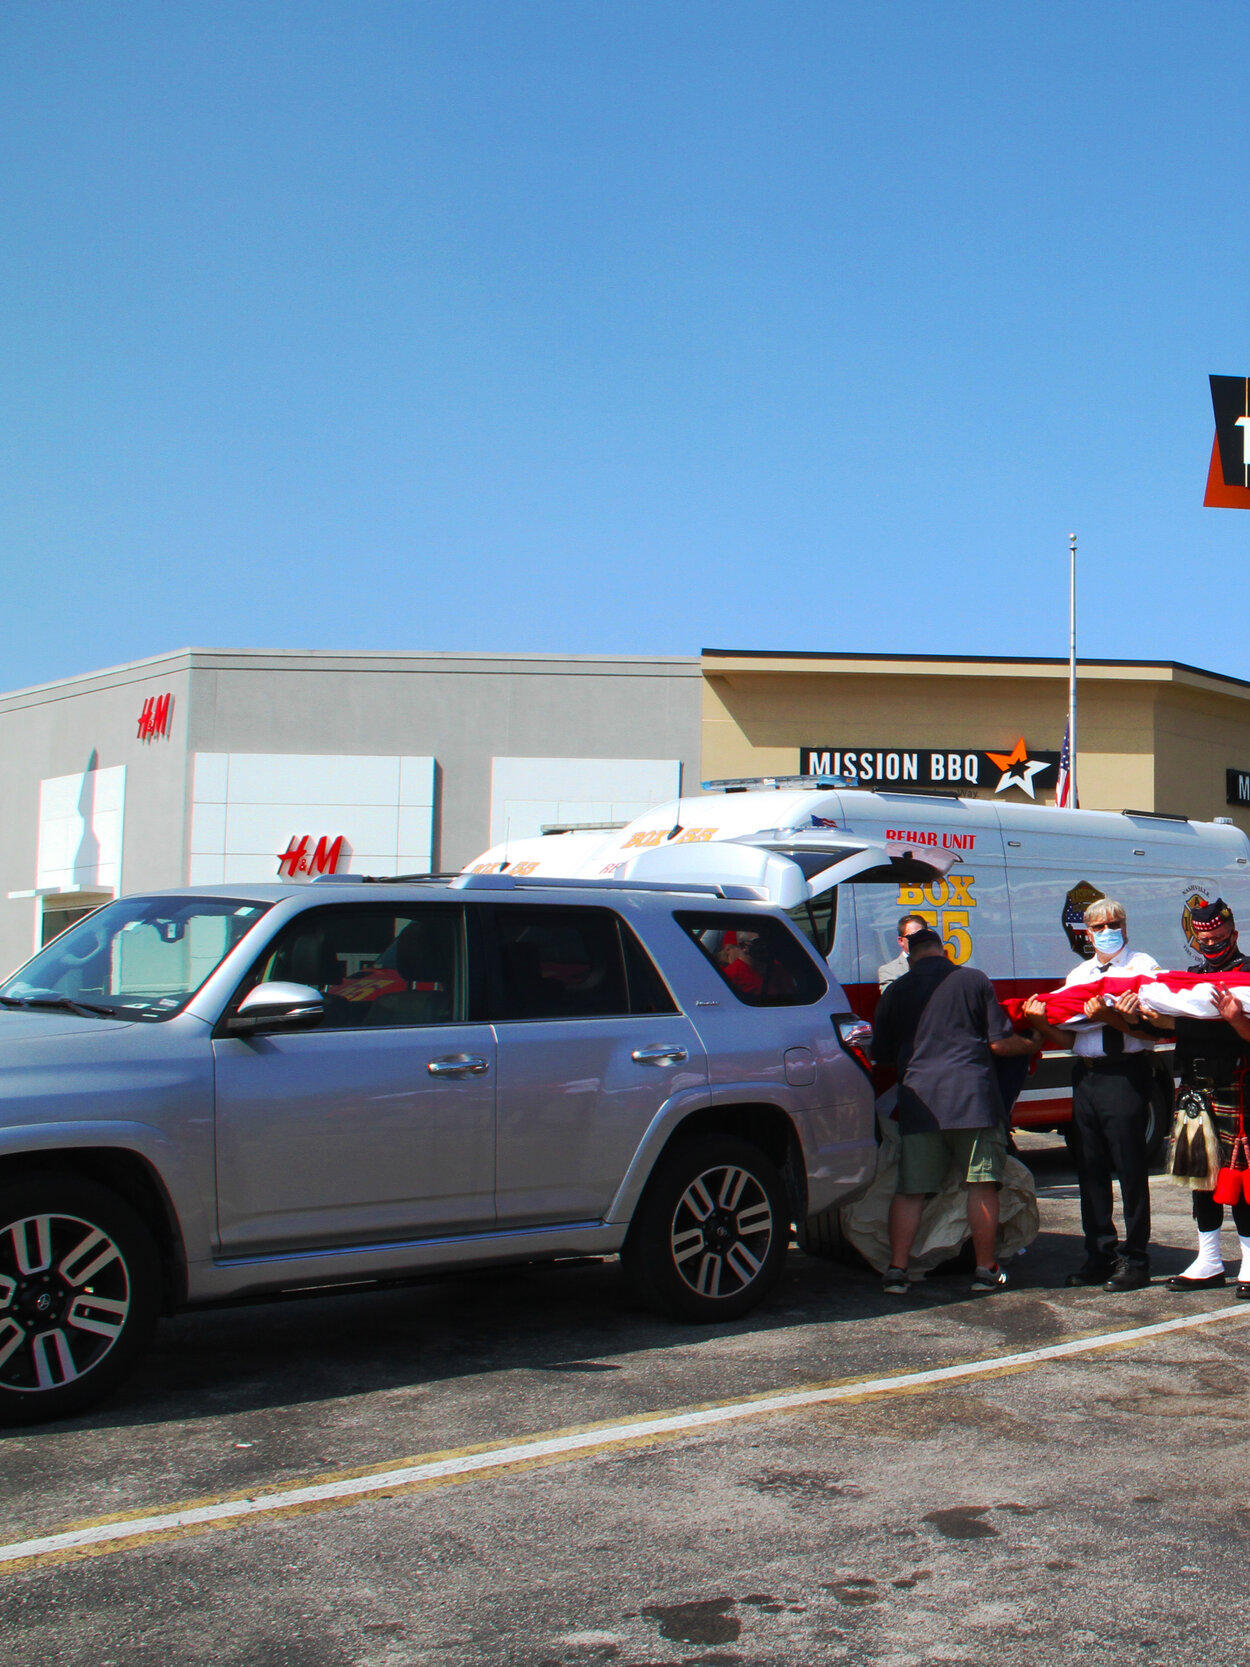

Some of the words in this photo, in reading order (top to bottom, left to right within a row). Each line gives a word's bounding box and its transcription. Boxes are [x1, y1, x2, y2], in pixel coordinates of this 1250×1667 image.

[137, 693, 172, 740] H&M
[808, 752, 918, 782] MISSION
[930, 753, 979, 785] BBQ
[675, 827, 720, 844] 55
[885, 829, 938, 847] REHAB
[942, 833, 977, 850] UNIT
[276, 834, 345, 877] H&M
[896, 874, 978, 908] BOX
